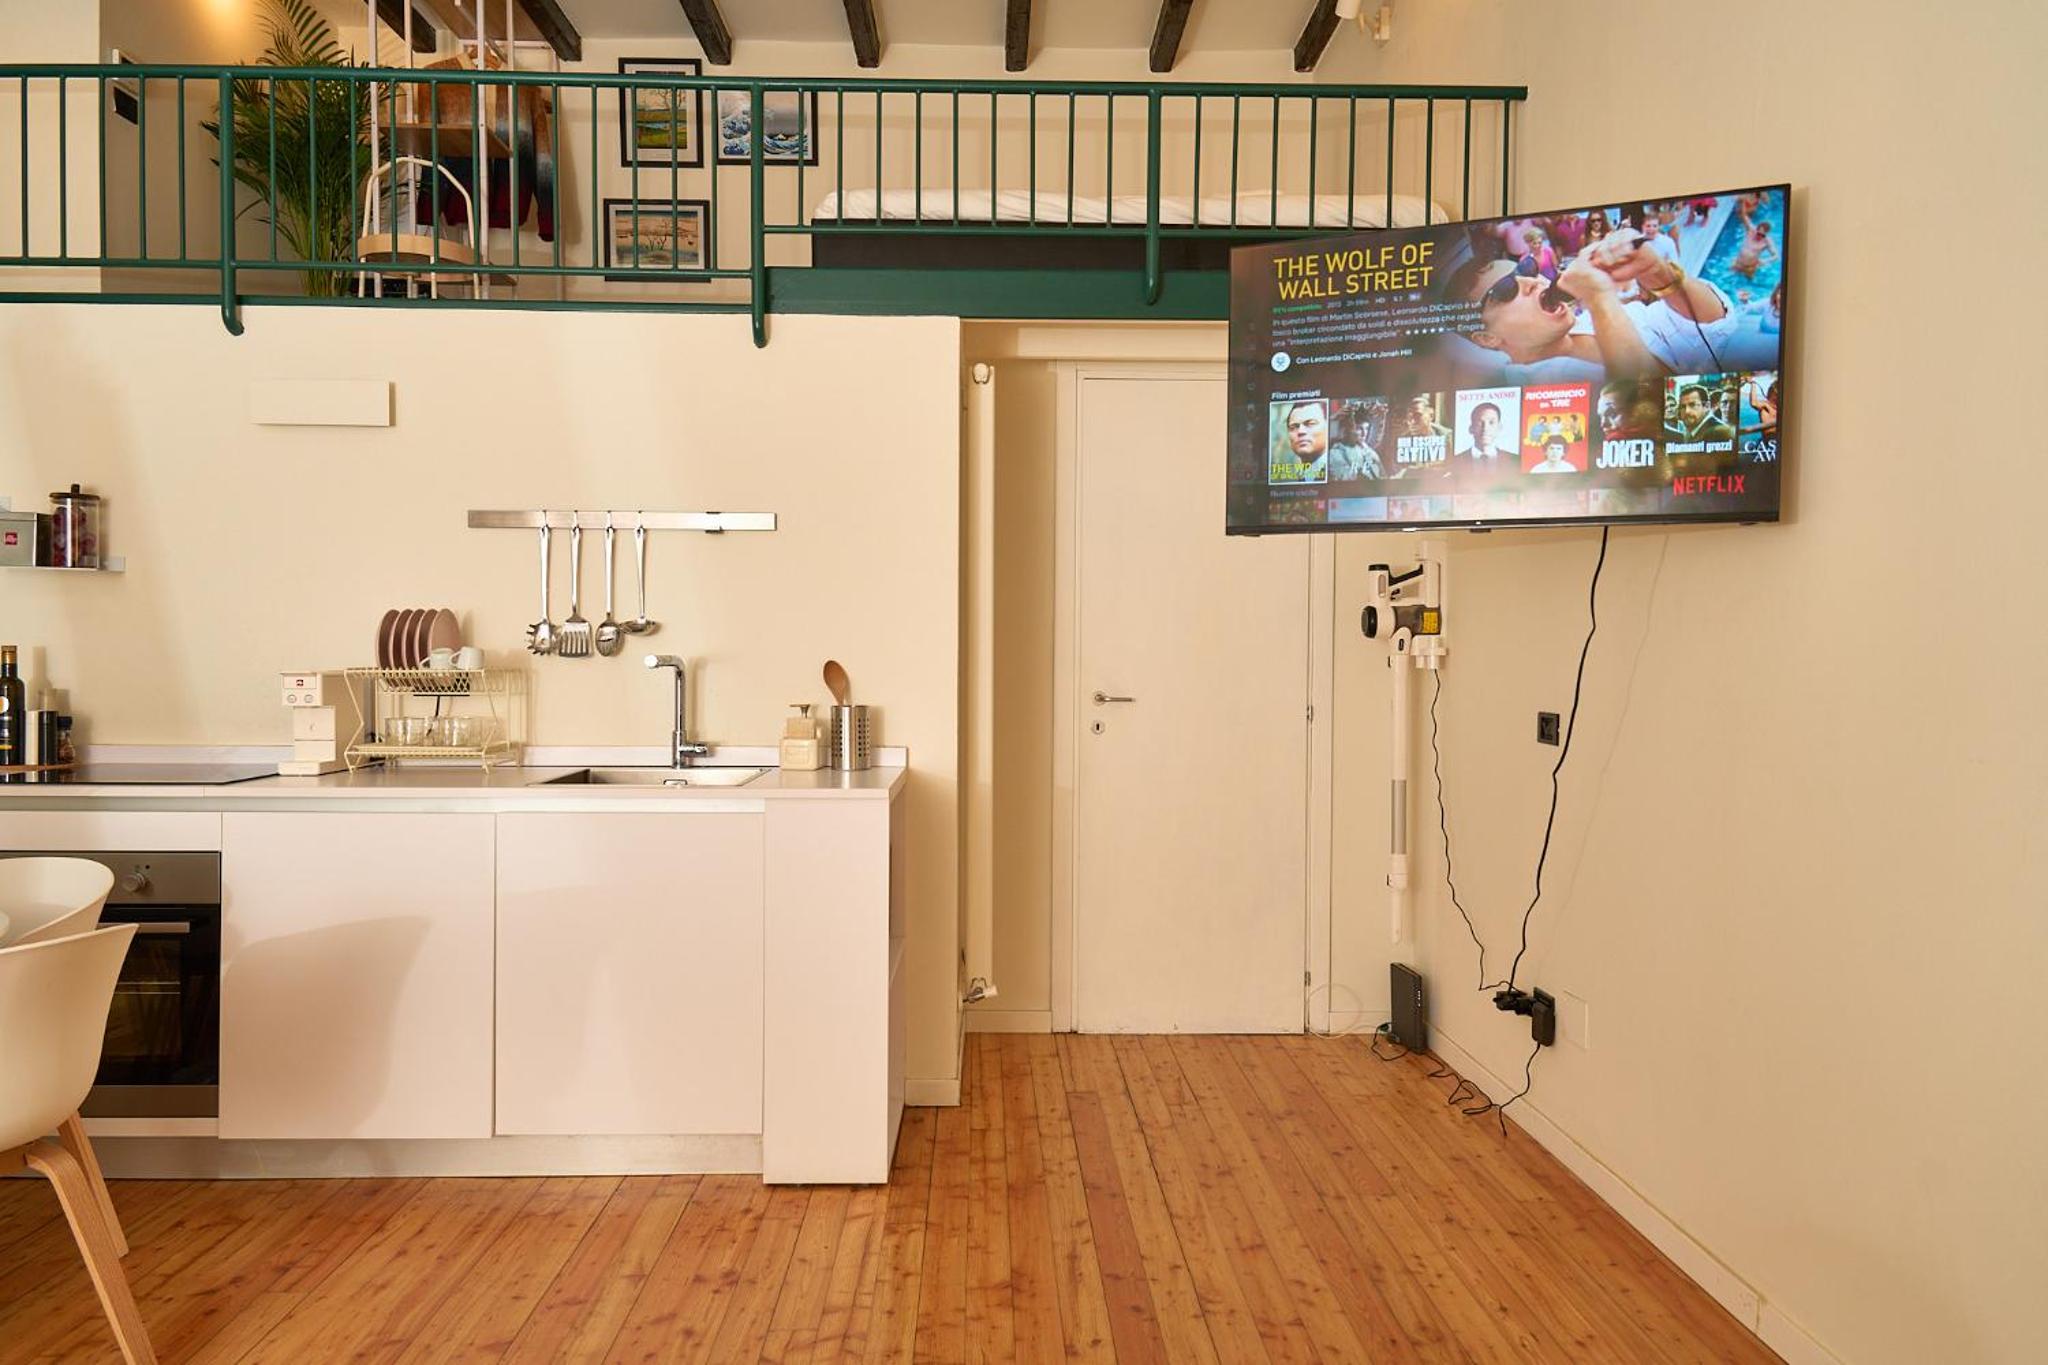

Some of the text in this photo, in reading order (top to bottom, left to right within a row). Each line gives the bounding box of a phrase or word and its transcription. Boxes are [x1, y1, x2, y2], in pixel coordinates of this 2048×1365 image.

[1273, 242, 1435, 279] THE WOLF OF
[1278, 266, 1433, 300] WALL STREET
[1329, 312, 1354, 321] Martin
[1392, 305, 1428, 316] Leonardo
[1429, 302, 1464, 313] DiCaprio
[1293, 327, 1315, 335] broker
[1317, 323, 1356, 333] circondato
[1393, 315, 1440, 326] dissolutezza
[1441, 313, 1456, 321] che
[1457, 312, 1482, 322] regala
[1457, 323, 1485, 333] Empire
[1296, 356, 1309, 364] Con
[1310, 354, 1341, 363] Leonardo
[1343, 352, 1371, 361] DiCaprio
[1378, 350, 1399, 358] Jonah
[1400, 348, 1412, 356] Hill
[1271, 389, 1320, 400] Film premiati
[1596, 438, 1654, 469] JOKER
[1665, 441, 1704, 454] Diamanti
[1271, 463, 1293, 474] THE
[1673, 474, 1745, 496] NETFLIX
